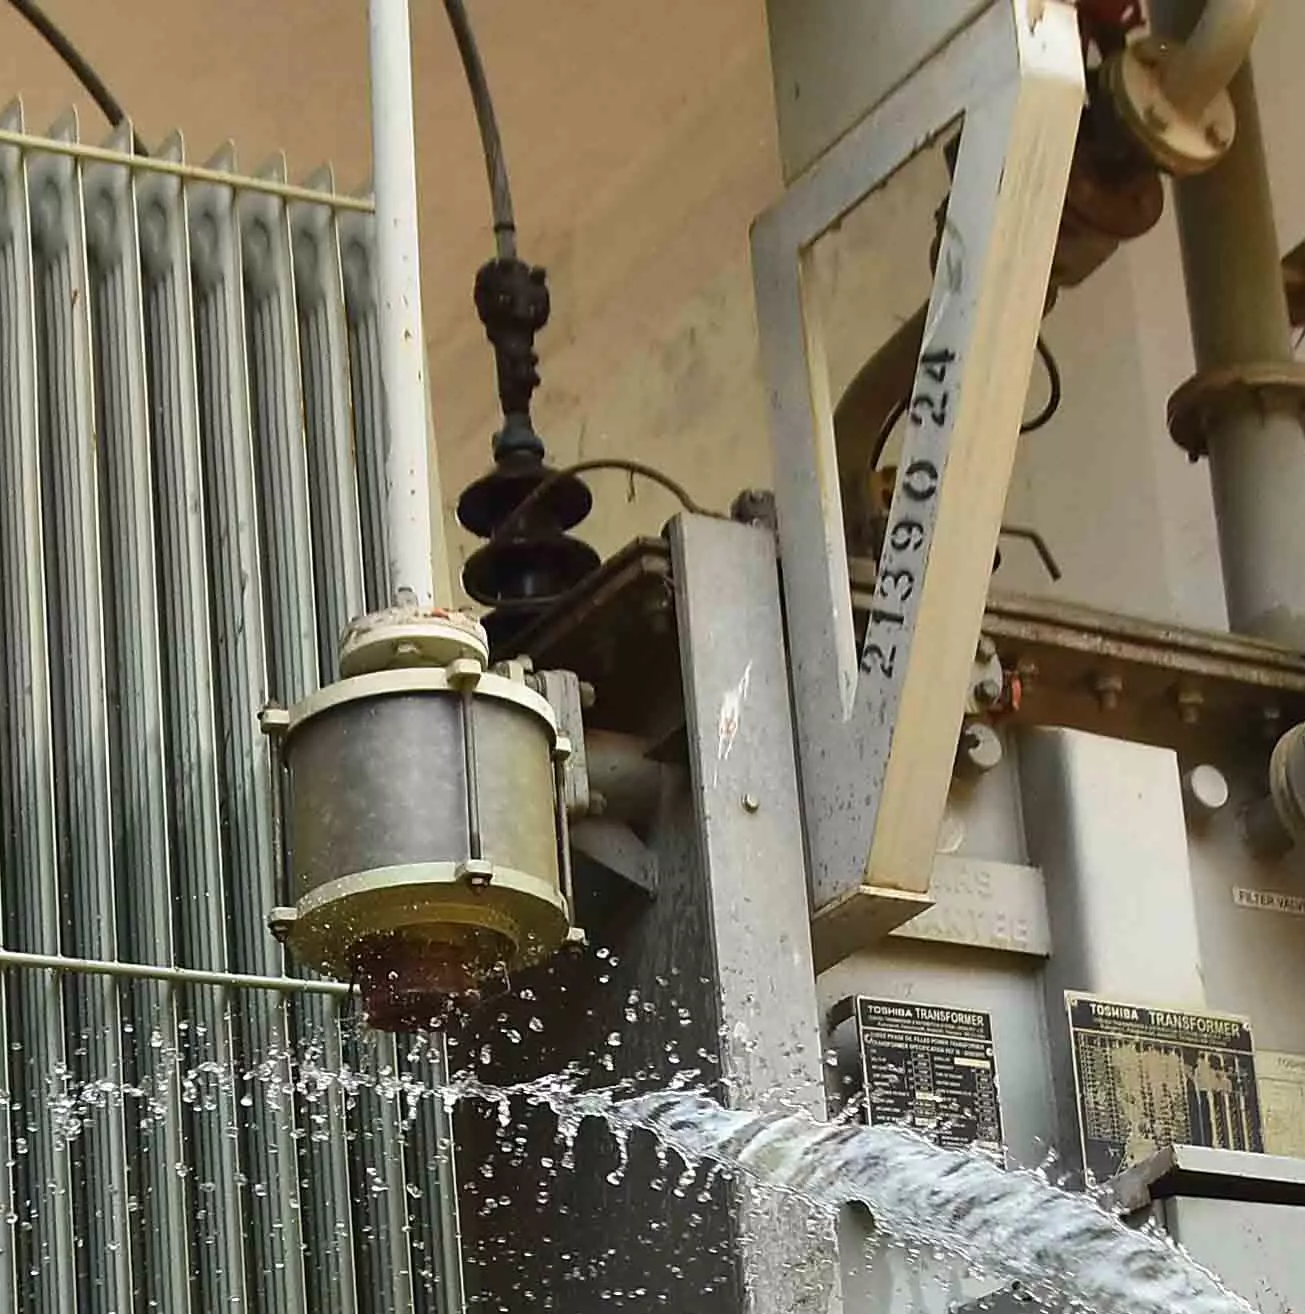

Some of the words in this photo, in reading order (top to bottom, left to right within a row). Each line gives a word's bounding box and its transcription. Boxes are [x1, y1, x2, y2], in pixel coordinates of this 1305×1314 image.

[867, 1004, 913, 1018] TOSHIBA
[914, 1007, 985, 1027] TRANSFORMER
[1089, 1003, 1140, 1022] TOSHIBA
[1148, 1011, 1241, 1038] TRANSFORMER
